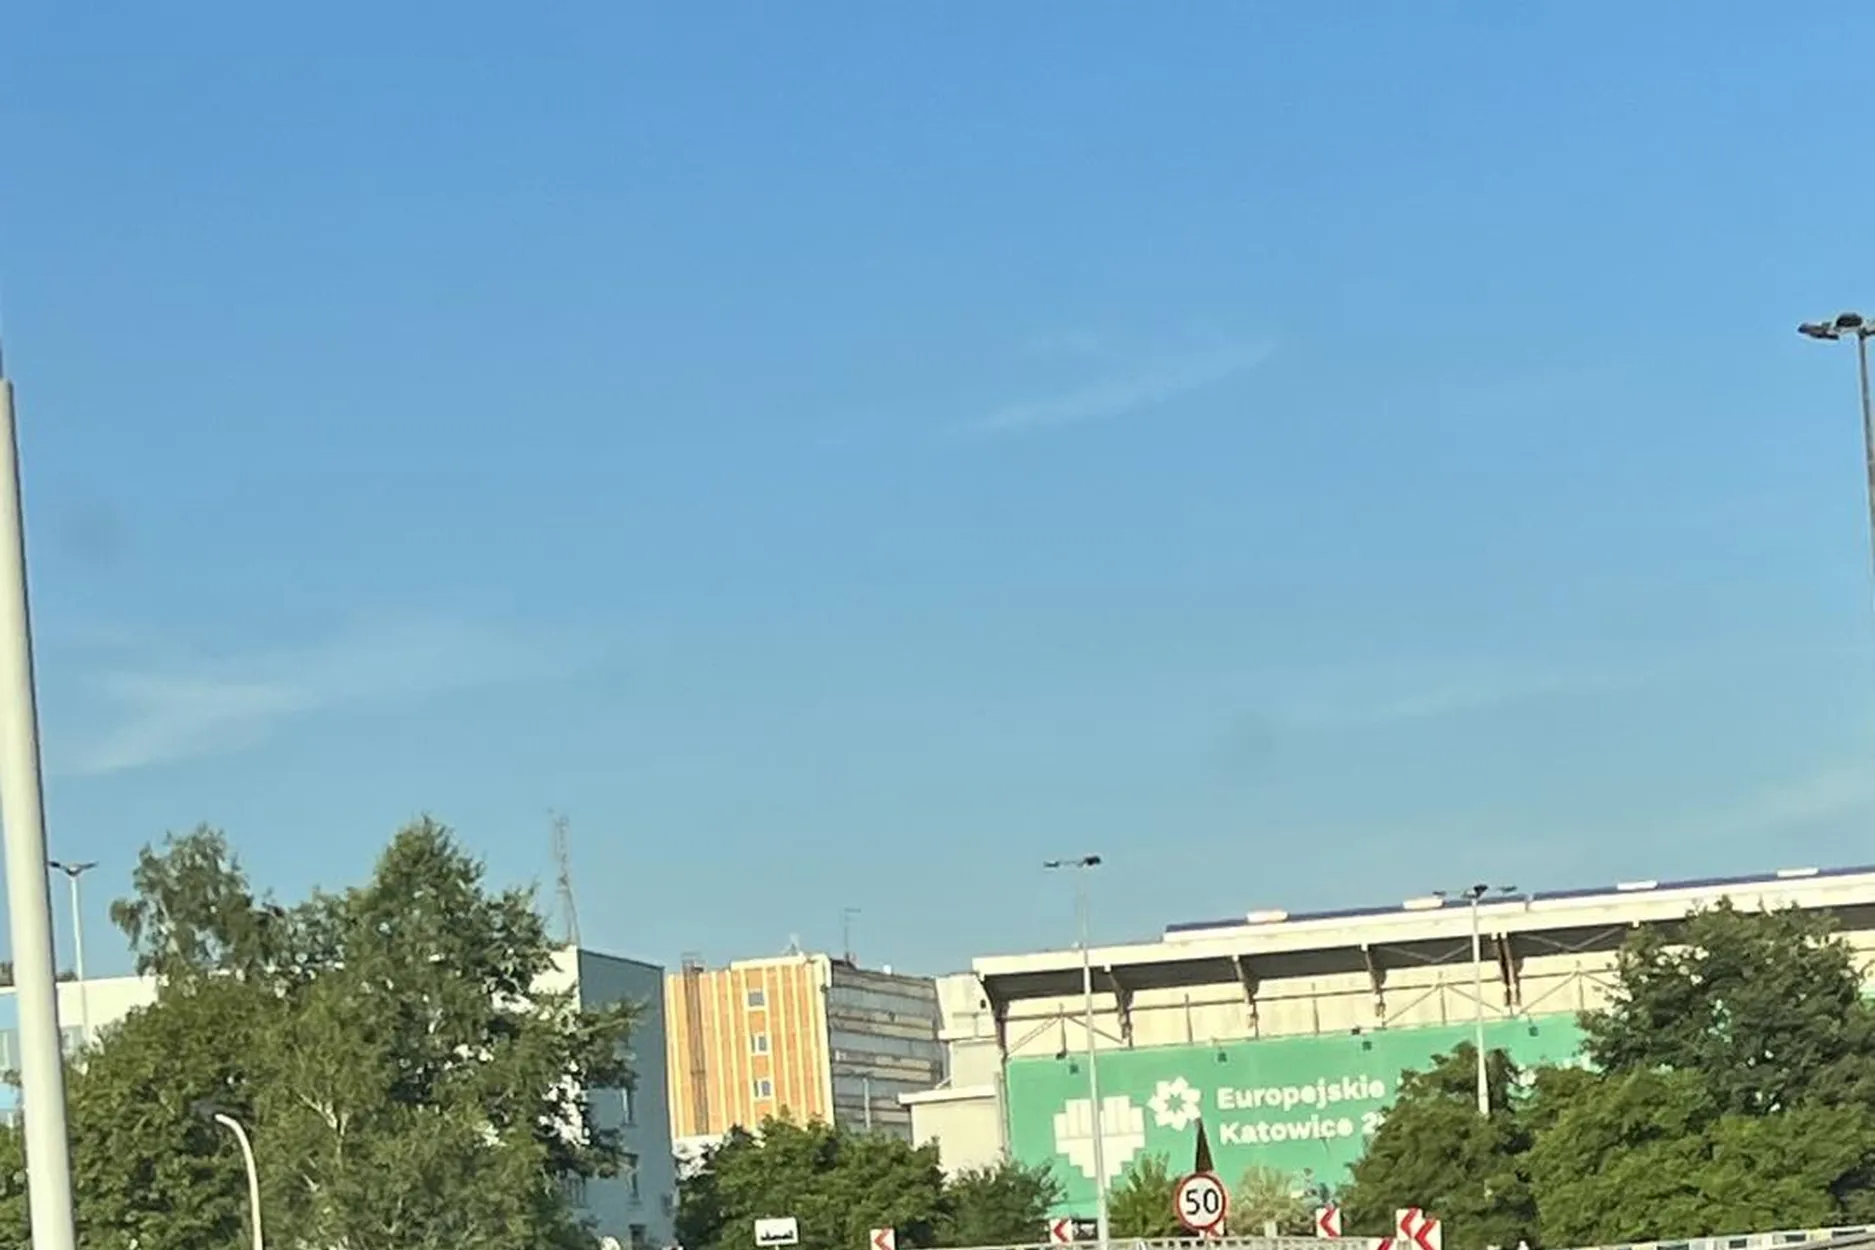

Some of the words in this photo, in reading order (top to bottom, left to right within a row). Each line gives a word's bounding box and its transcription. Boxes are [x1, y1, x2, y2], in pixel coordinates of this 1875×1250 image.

[1217, 1075, 1385, 1111] Europejskie
[1218, 1114, 1354, 1145] Katowice
[1186, 1187, 1219, 1215] 50
